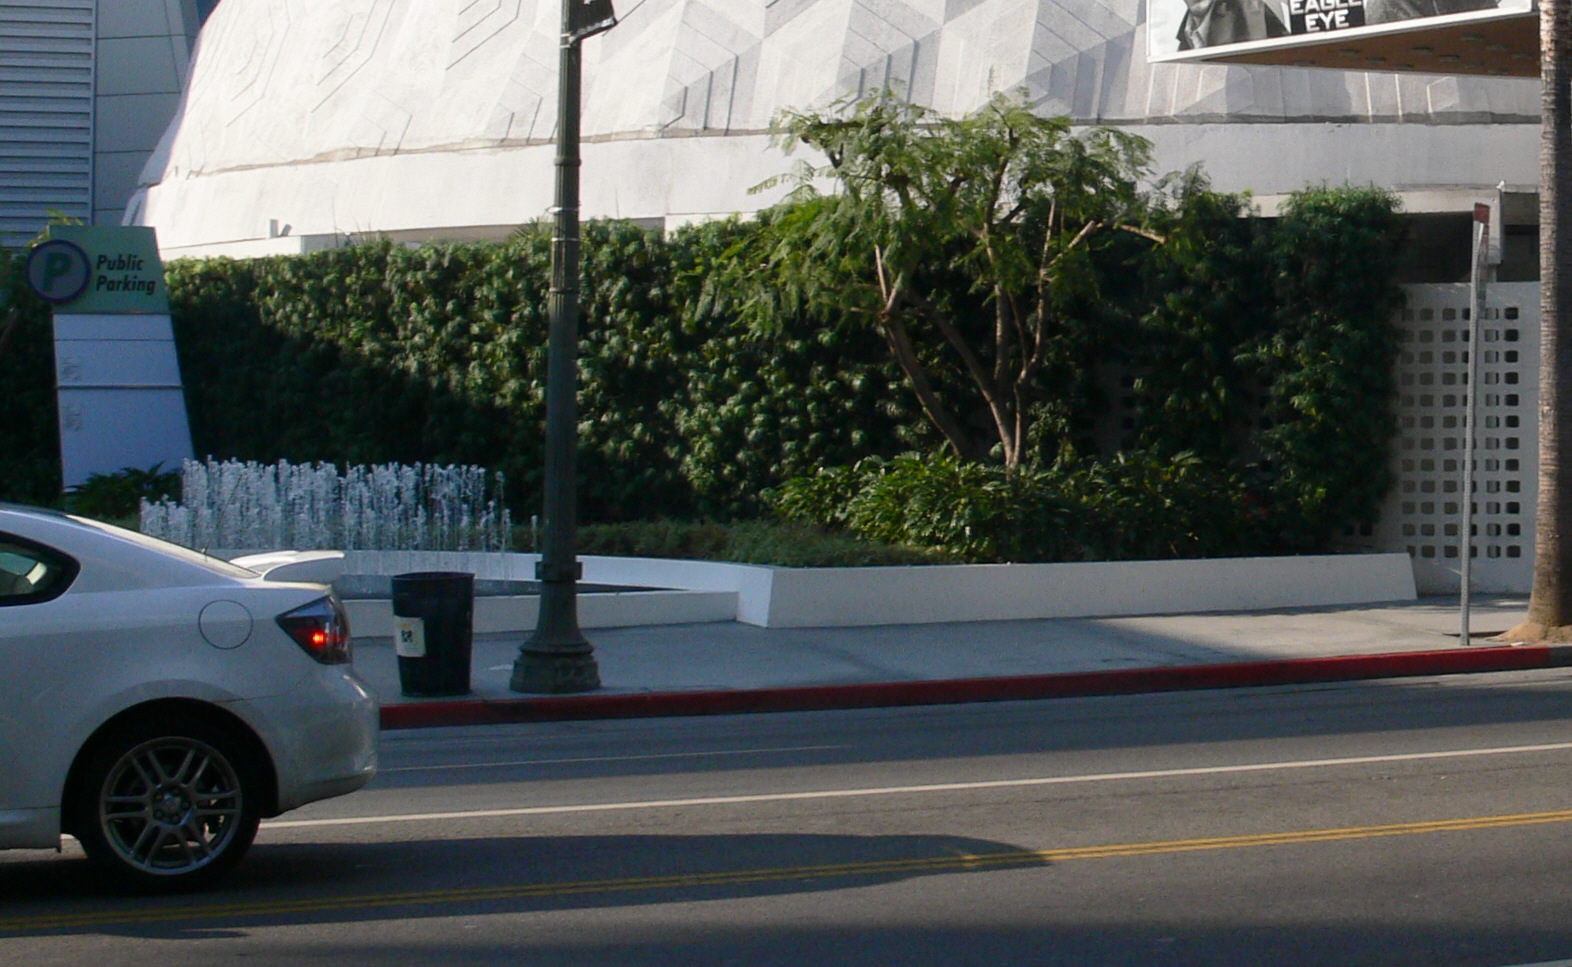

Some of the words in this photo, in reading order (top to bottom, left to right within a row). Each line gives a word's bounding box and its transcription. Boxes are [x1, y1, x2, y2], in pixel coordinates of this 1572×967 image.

[1304, 9, 1350, 33] EYE
[96, 254, 144, 271] Public
[96, 275, 156, 295] Parking
